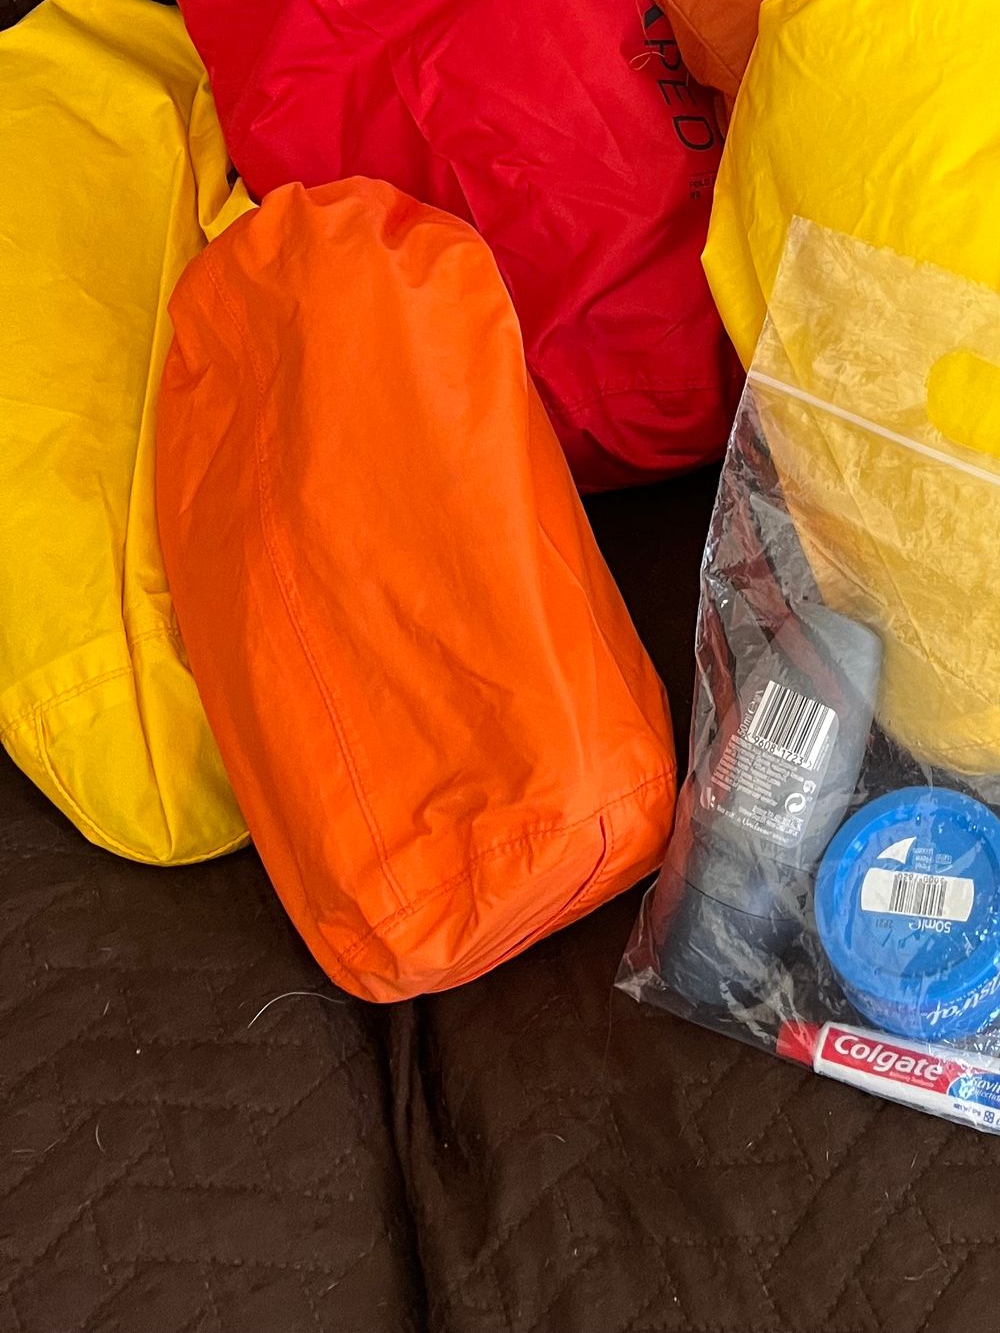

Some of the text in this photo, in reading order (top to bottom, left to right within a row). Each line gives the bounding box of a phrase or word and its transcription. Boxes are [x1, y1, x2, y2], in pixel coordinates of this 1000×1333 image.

[754, 736, 804, 766] 9608 1723
[834, 1033, 945, 1082] Colgate
